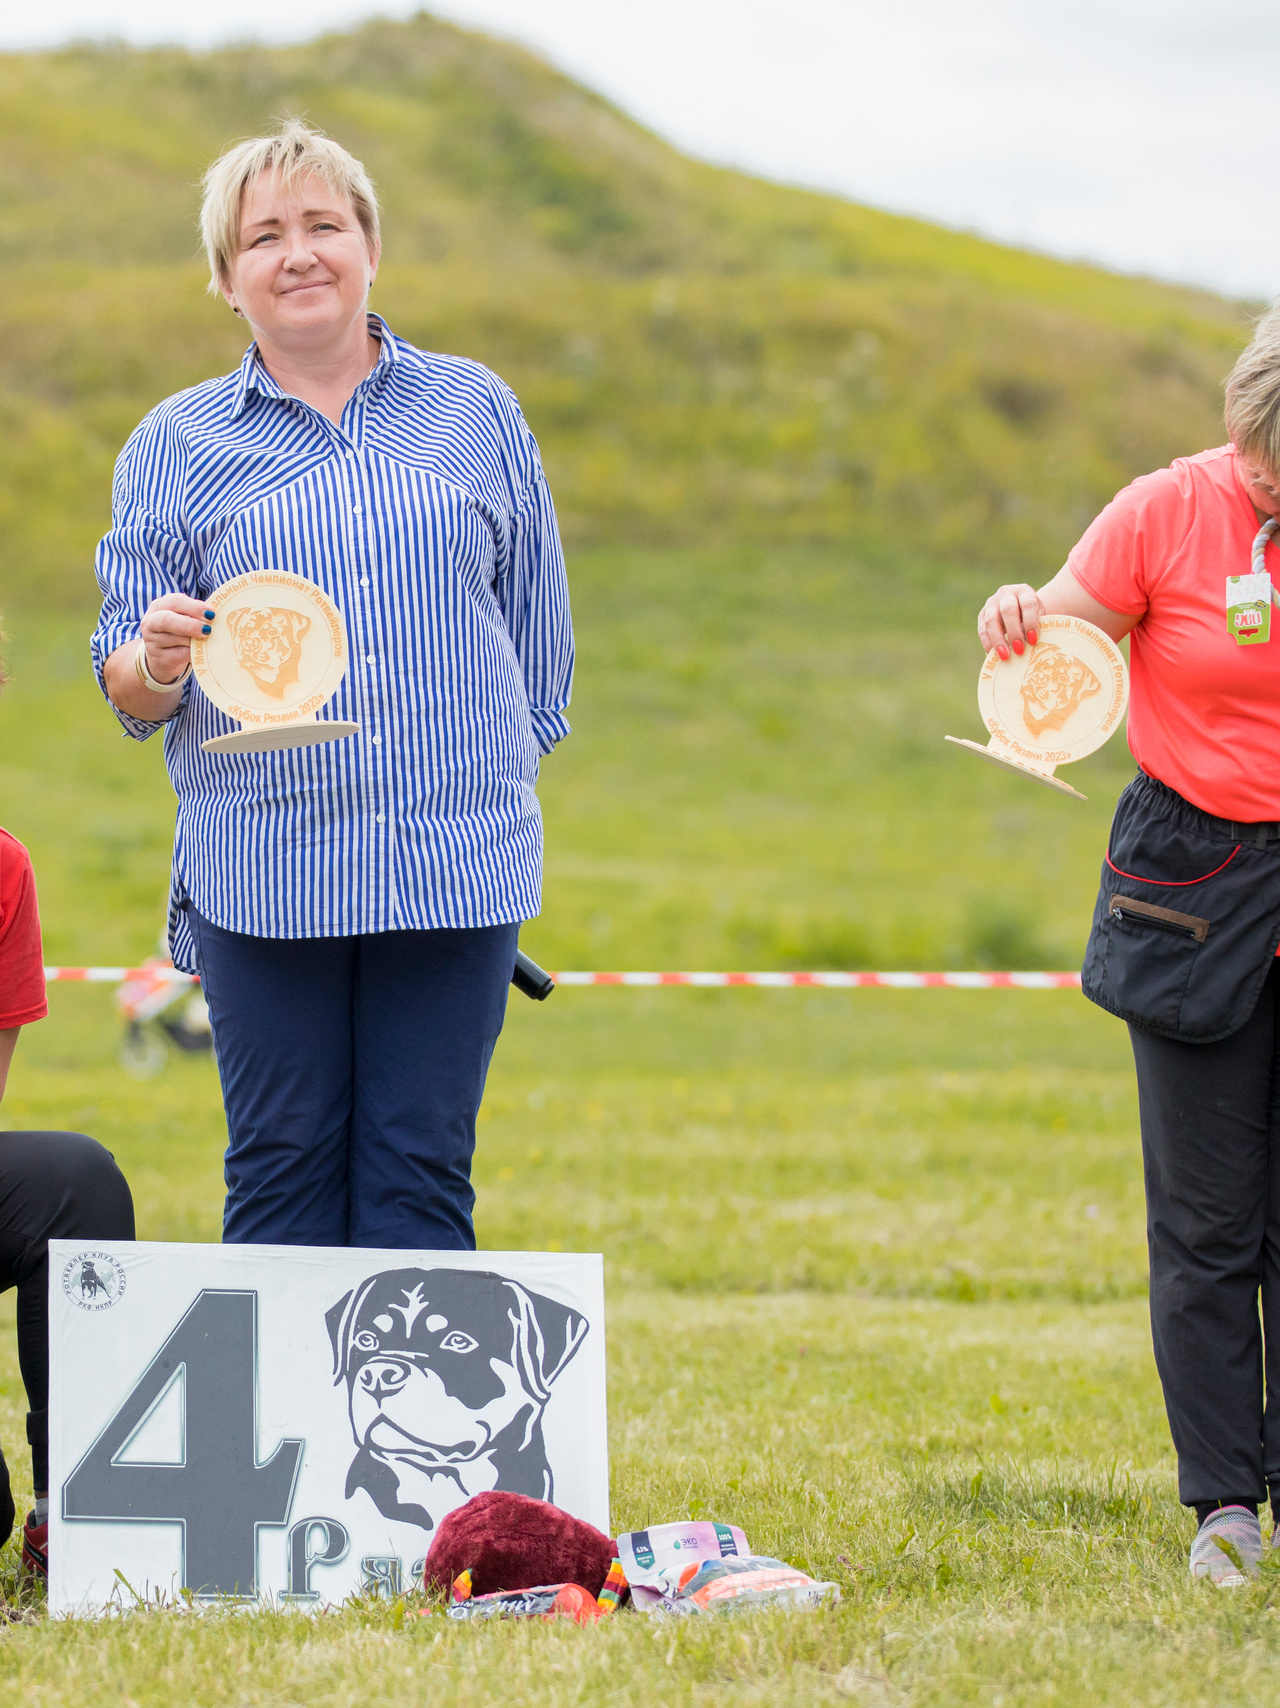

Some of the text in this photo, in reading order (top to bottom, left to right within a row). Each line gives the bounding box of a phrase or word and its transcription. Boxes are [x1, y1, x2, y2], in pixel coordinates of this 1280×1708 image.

[250, 573, 311, 594] Чемпионат
[310, 588, 343, 658] Ротвейлеров
[1073, 620, 1119, 664] Чемпионат
[1101, 664, 1127, 732] Ротвейлеров
[227, 692, 325, 723] «Кубок Рязани 2023»
[1011, 741, 1043, 761] Рязани
[1044, 751, 1072, 762] 2023»
[92, 1252, 114, 1264] КЛУБ
[62, 1289, 306, 1601] 4
[681, 1537, 698, 1546] ЭКО
